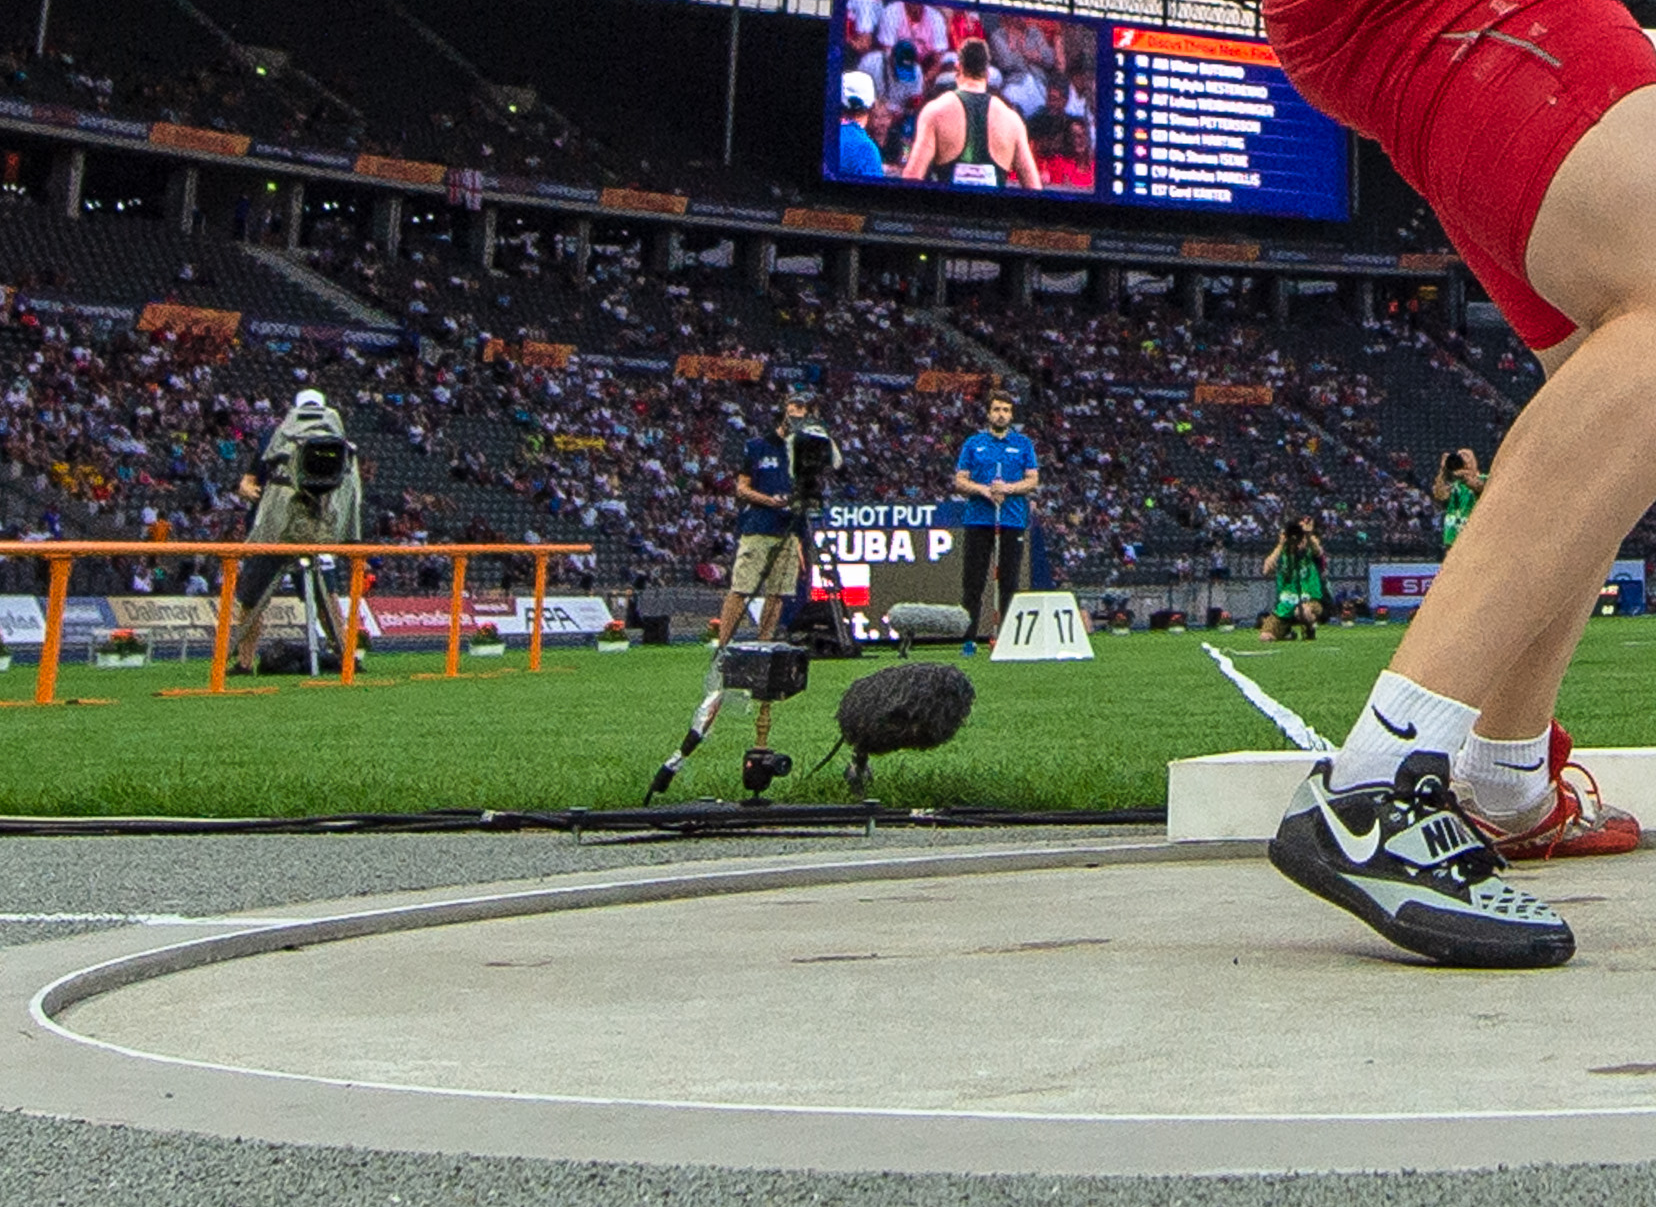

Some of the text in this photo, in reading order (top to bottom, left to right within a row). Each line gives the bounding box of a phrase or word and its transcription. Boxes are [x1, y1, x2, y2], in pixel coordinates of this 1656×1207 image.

[829, 504, 938, 528] SHOT PUT
[927, 529, 953, 562] P
[121, 599, 201, 626] Dallmayr
[1013, 608, 1040, 646] 17
[1052, 608, 1075, 645] 17
